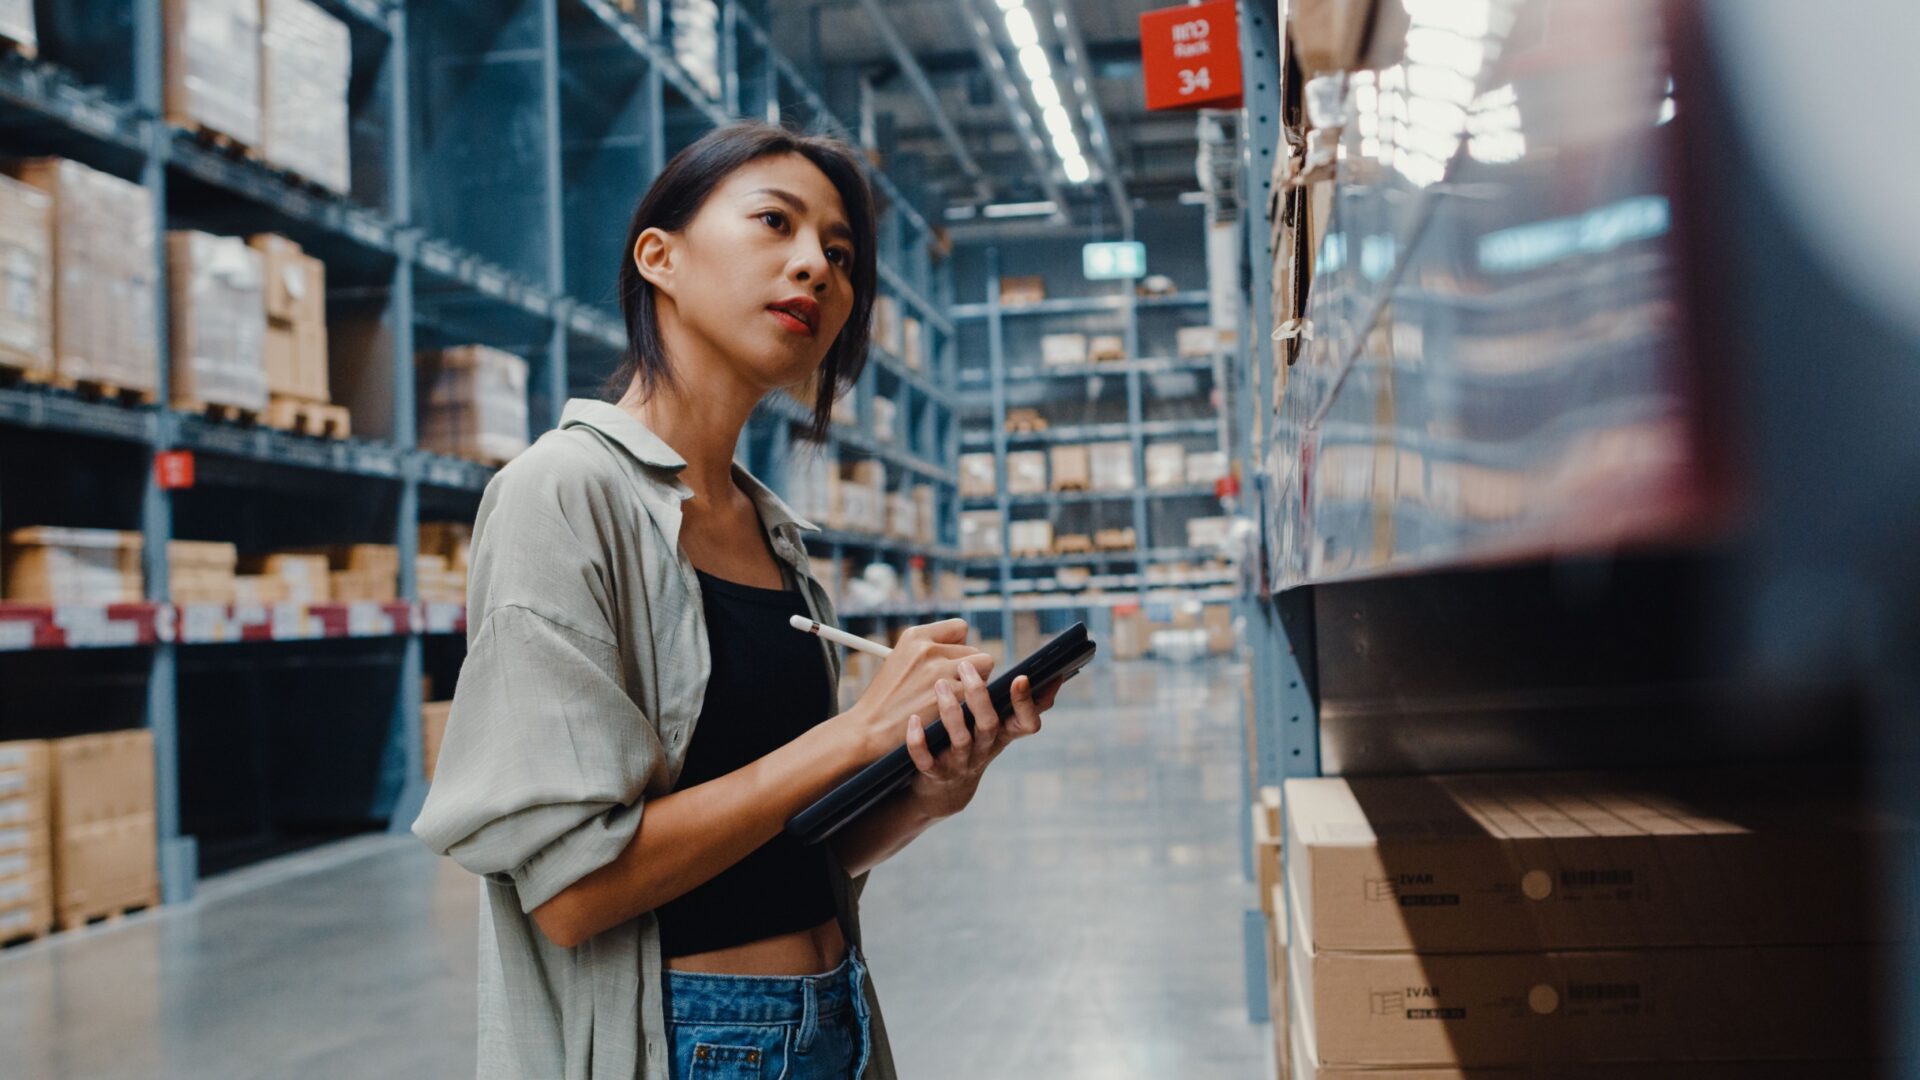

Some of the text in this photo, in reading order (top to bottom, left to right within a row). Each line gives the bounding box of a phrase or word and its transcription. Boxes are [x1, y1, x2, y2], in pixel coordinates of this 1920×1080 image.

[1178, 67, 1212, 95] 34
[1400, 873, 1434, 885] IVAR
[1407, 986, 1440, 998] IVAR
